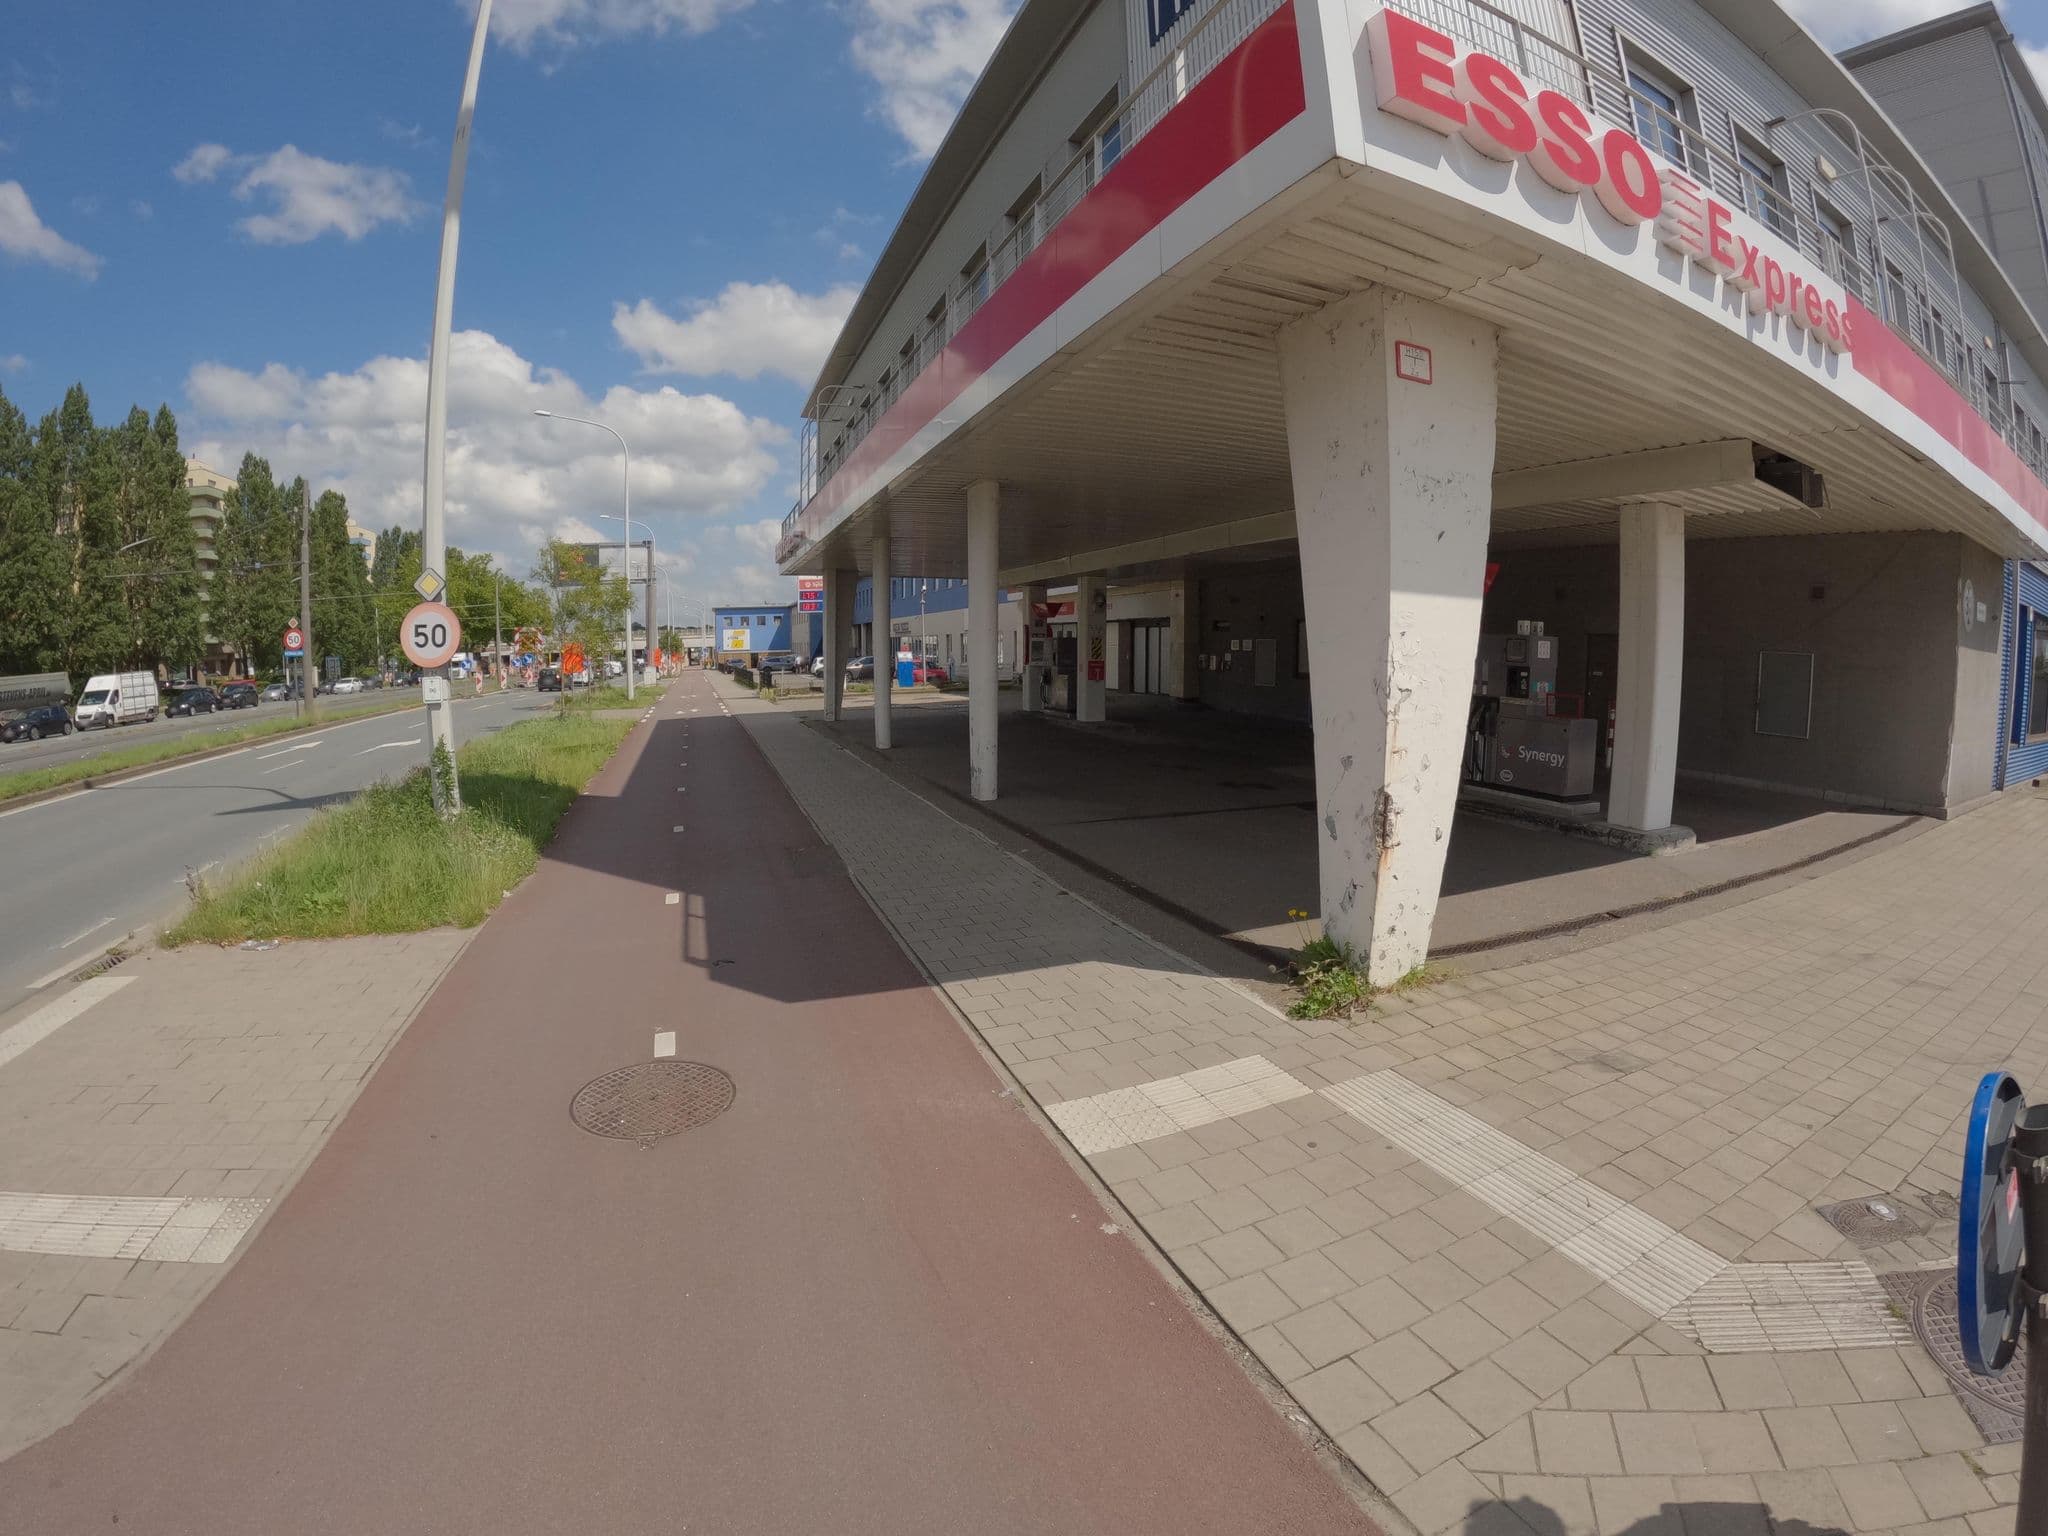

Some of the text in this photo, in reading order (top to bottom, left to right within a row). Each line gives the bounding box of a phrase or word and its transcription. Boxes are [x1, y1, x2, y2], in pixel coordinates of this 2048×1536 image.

[1384, 8, 1854, 353] ESSO Express
[288, 635, 300, 645] 50
[414, 624, 446, 648] 50
[1518, 745, 1565, 767] Synergy
